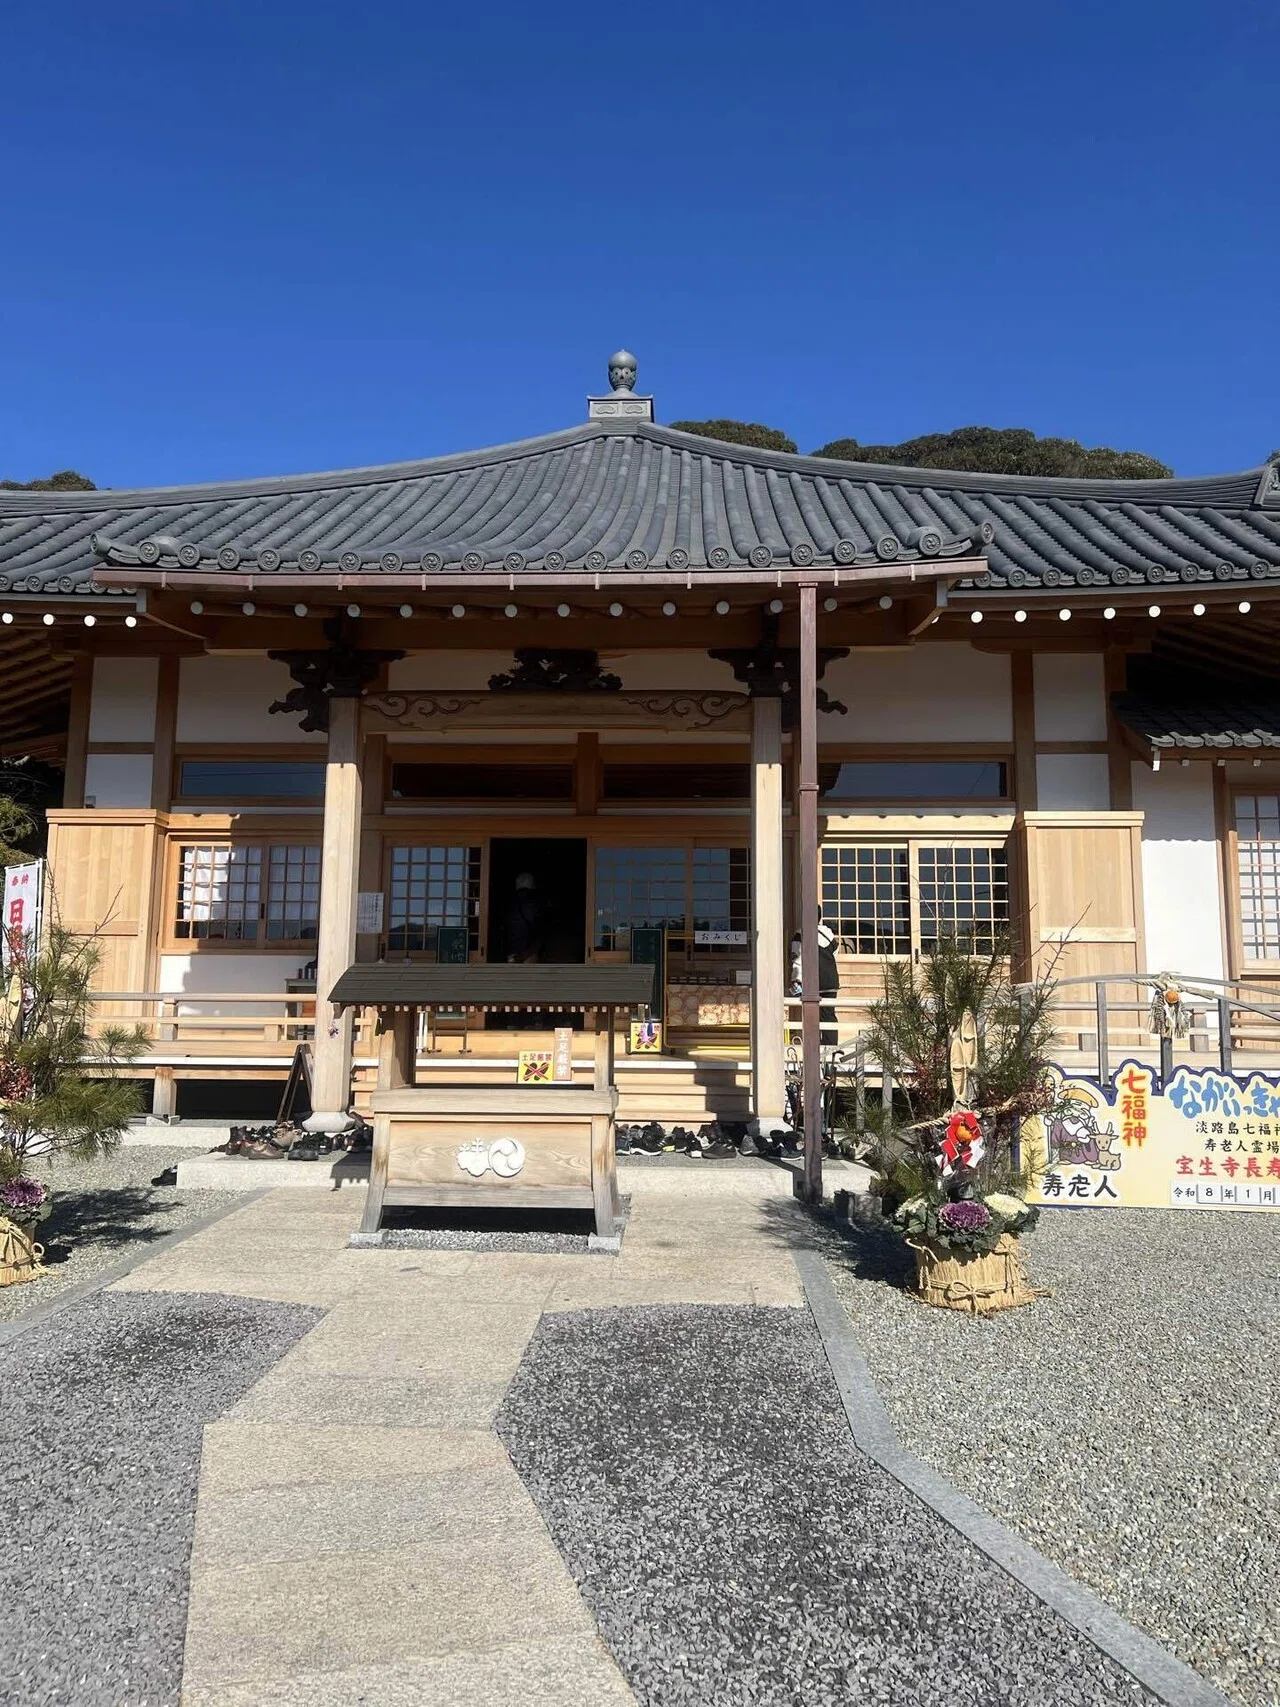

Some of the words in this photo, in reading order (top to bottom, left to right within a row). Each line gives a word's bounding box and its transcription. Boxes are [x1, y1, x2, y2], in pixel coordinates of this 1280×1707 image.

[701, 933, 741, 941] おみくじ
[522, 1053, 552, 1061] 土足厳禁
[1121, 1069, 1147, 1148] 七福神
[1205, 1138, 1280, 1154] 寿老人霊場
[1176, 1155, 1280, 1179] 宝生寺長寿
[1043, 1174, 1118, 1199] 寿老人
